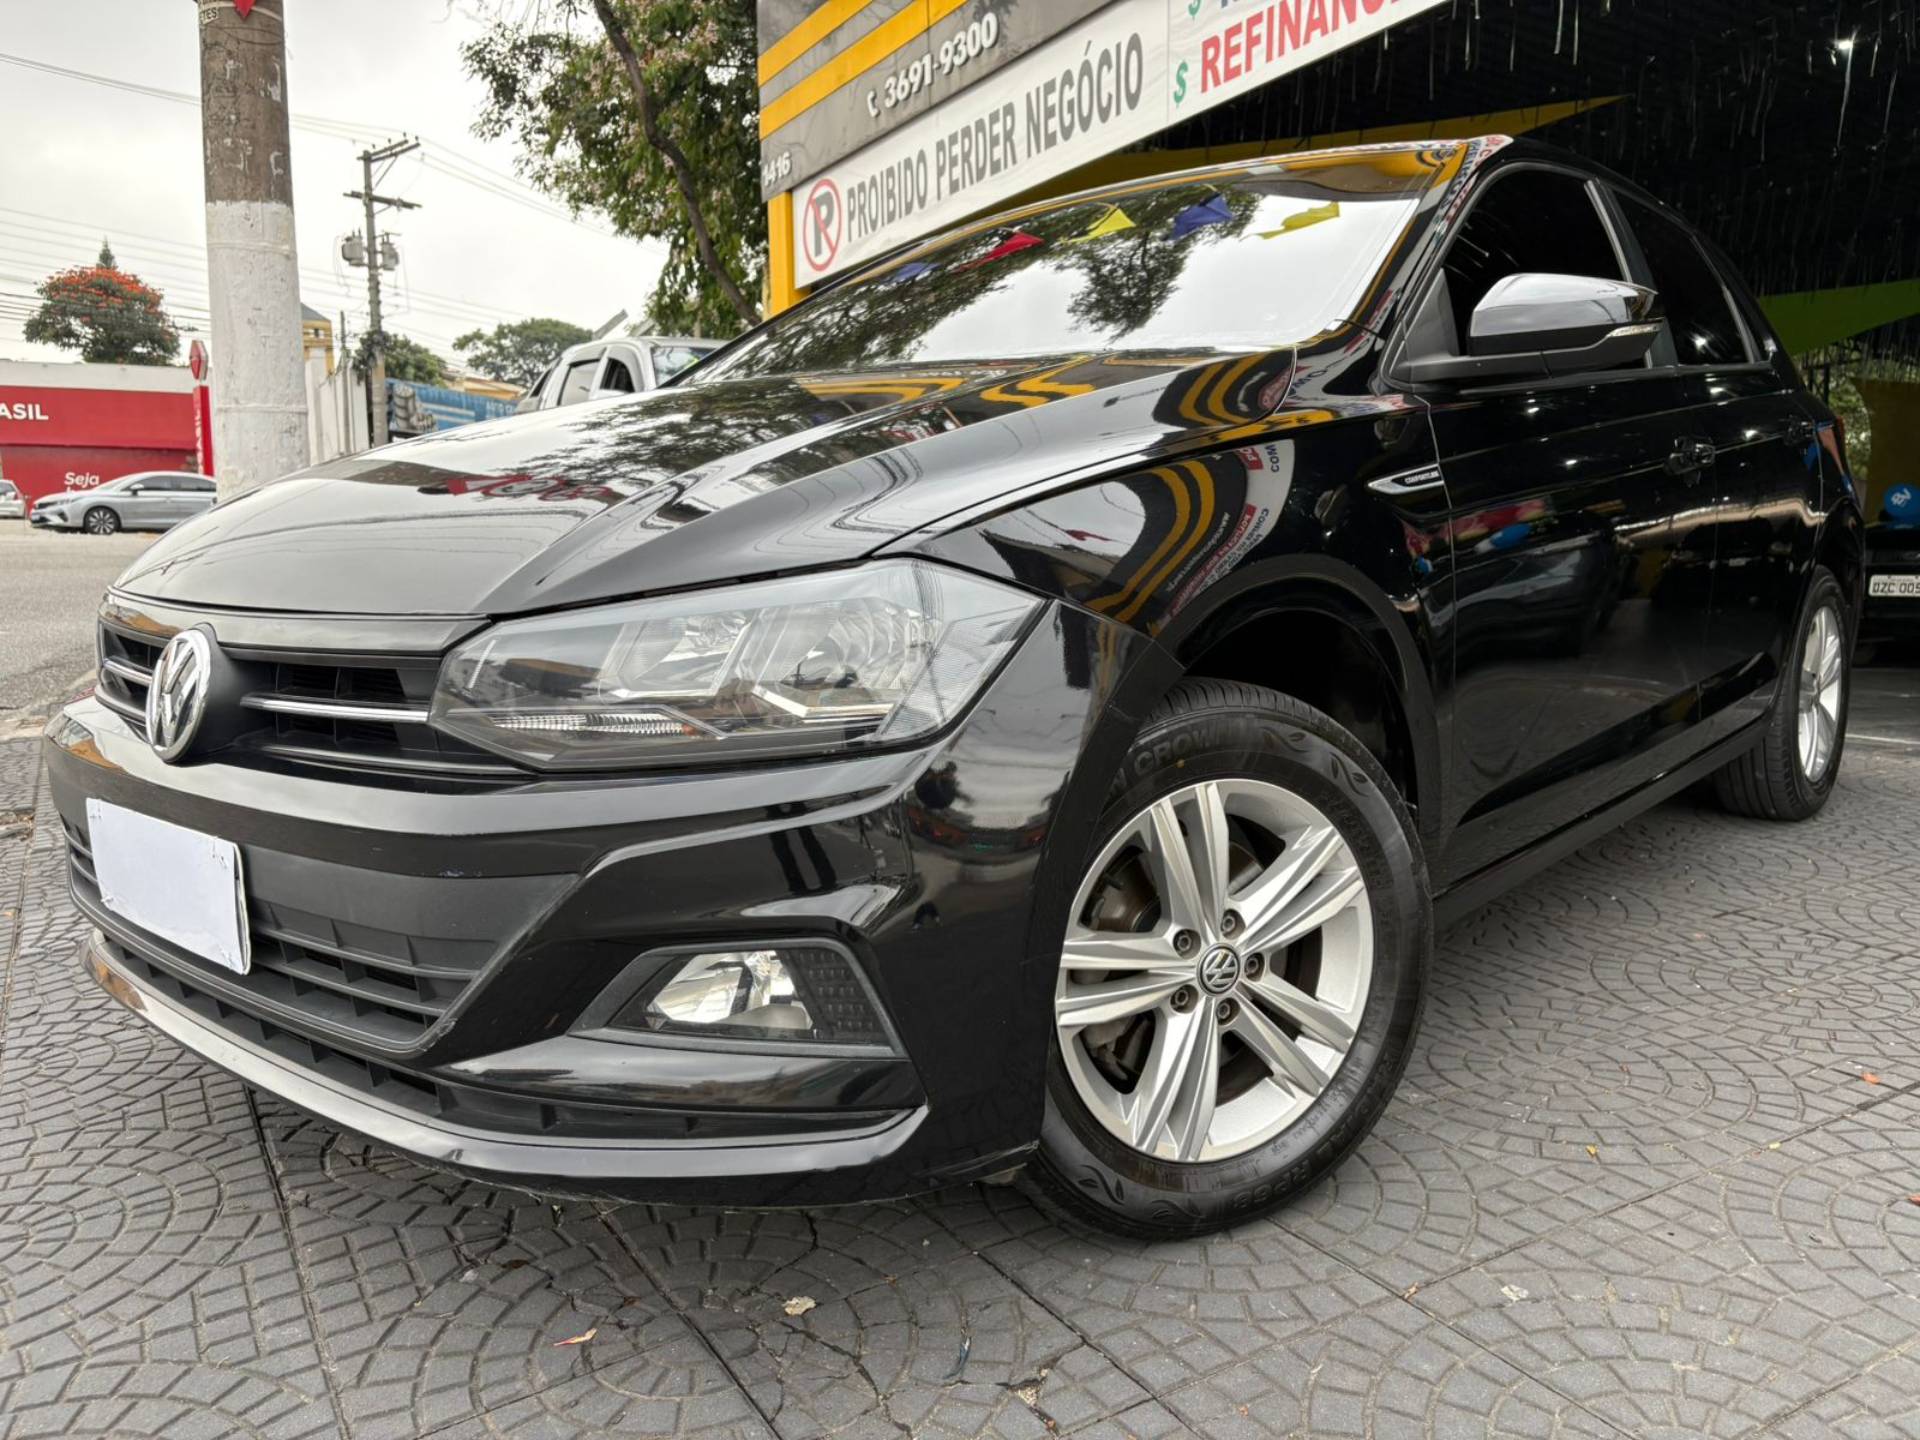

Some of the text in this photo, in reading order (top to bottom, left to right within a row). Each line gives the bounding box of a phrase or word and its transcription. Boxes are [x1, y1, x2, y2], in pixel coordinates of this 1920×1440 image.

[885, 12, 999, 108] 3691-9300
[1201, 0, 1399, 93] REFINAN
[848, 32, 1143, 242] PROIBIDO PERDER NEGÓCIO
[64, 471, 99, 488] Seja
